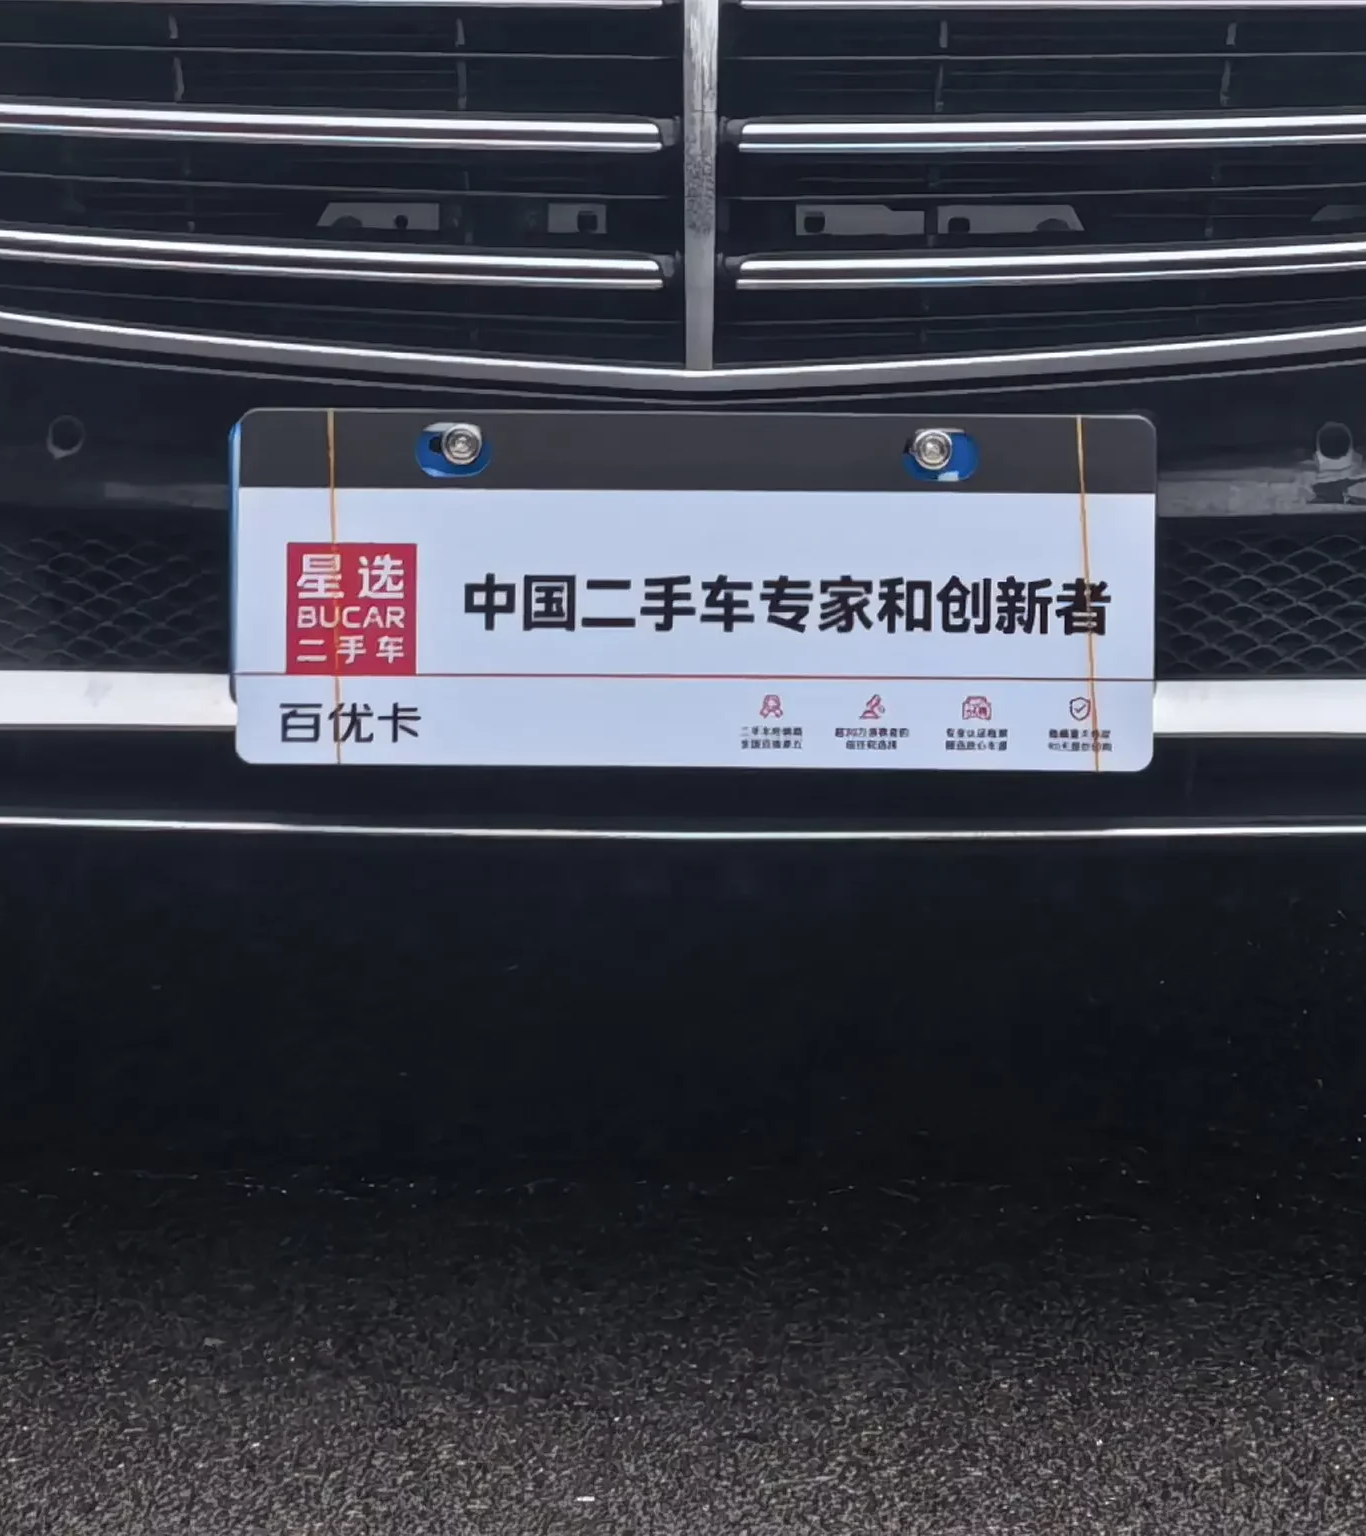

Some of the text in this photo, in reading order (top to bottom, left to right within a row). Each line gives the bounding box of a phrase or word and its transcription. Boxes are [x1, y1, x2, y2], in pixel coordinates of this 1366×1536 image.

[296, 553, 405, 600] 星选
[296, 606, 406, 629] BUCAR
[464, 572, 1112, 636] 中国二手车专家和创新者
[296, 635, 405, 664] 二手车
[279, 702, 422, 744] 百优卡
